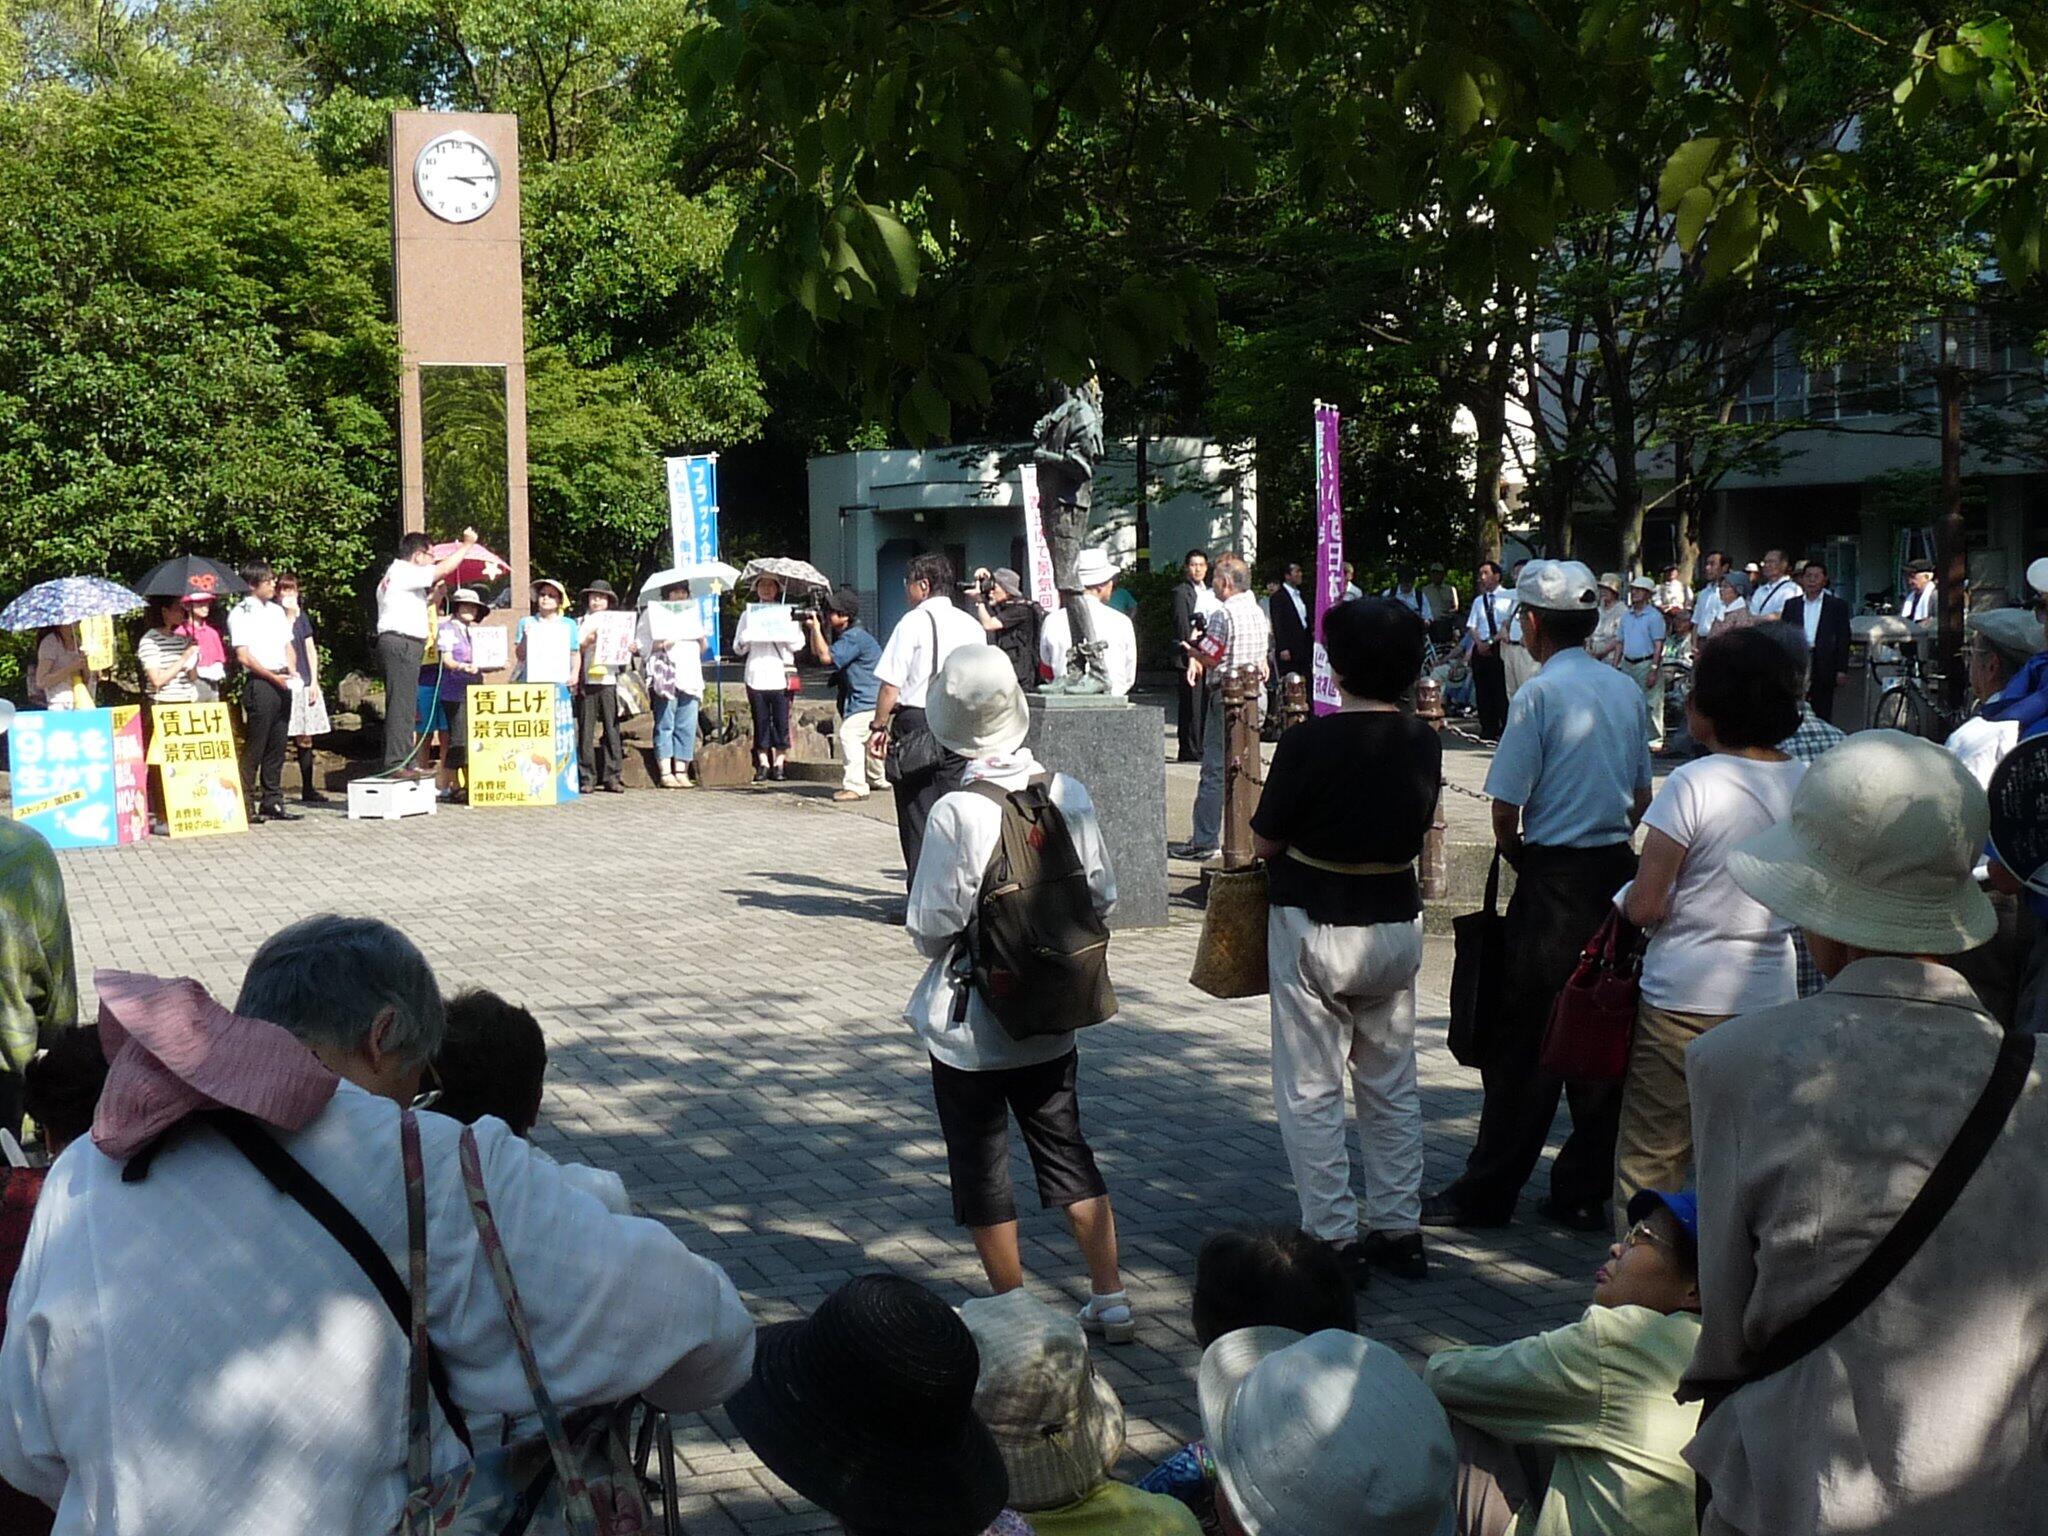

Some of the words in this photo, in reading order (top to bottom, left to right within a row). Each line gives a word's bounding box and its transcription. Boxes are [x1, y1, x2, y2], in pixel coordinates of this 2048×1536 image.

[473, 719, 551, 739] 景気回復
[164, 740, 232, 763] 景気回復
